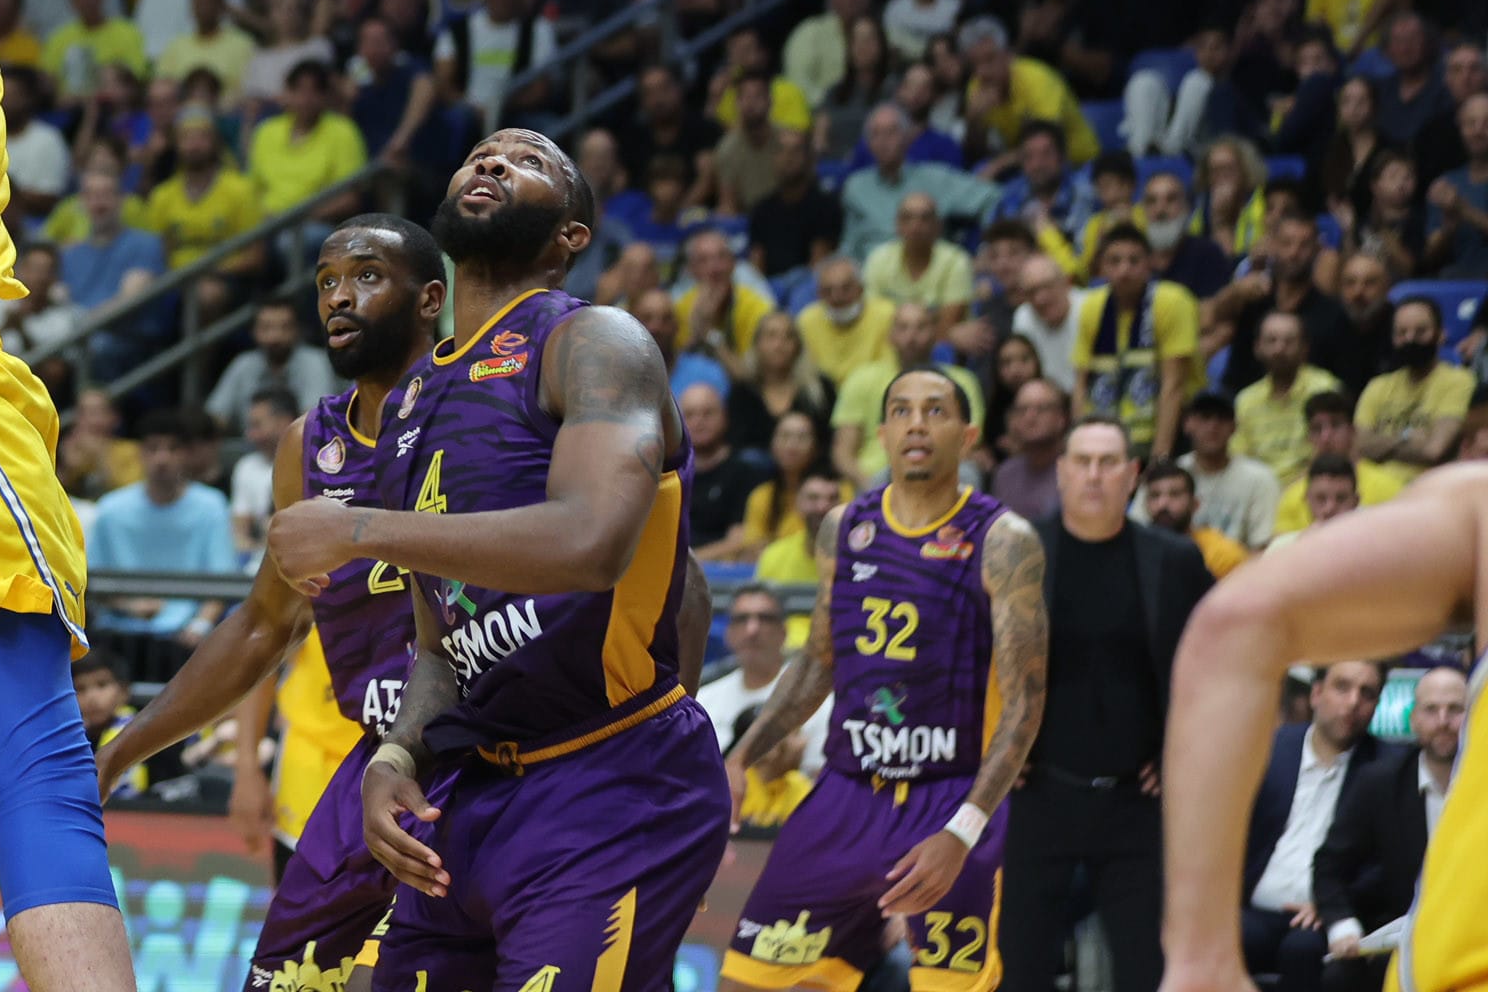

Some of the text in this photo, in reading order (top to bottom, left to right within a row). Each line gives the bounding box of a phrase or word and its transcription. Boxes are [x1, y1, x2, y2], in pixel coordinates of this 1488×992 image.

[415, 448, 446, 514] 4
[854, 596, 920, 661] 32
[917, 910, 986, 973] 32
